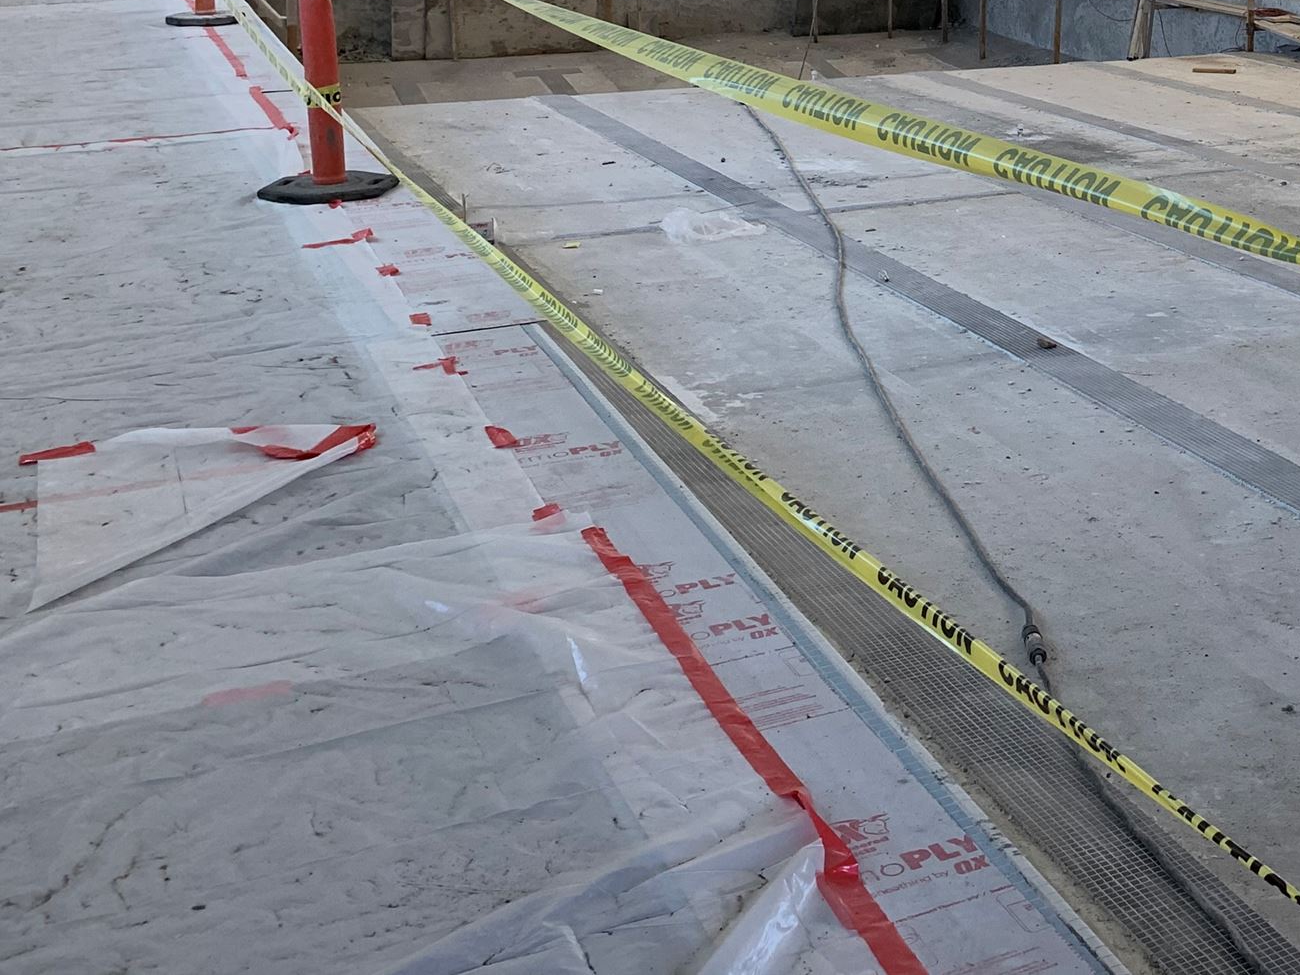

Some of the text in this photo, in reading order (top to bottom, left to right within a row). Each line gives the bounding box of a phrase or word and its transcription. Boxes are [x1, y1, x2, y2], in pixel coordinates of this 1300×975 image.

[750, 626, 779, 640] OX
[877, 567, 976, 656] CAUTION
[998, 660, 1127, 774] CAUTION
[953, 854, 991, 875] OX
